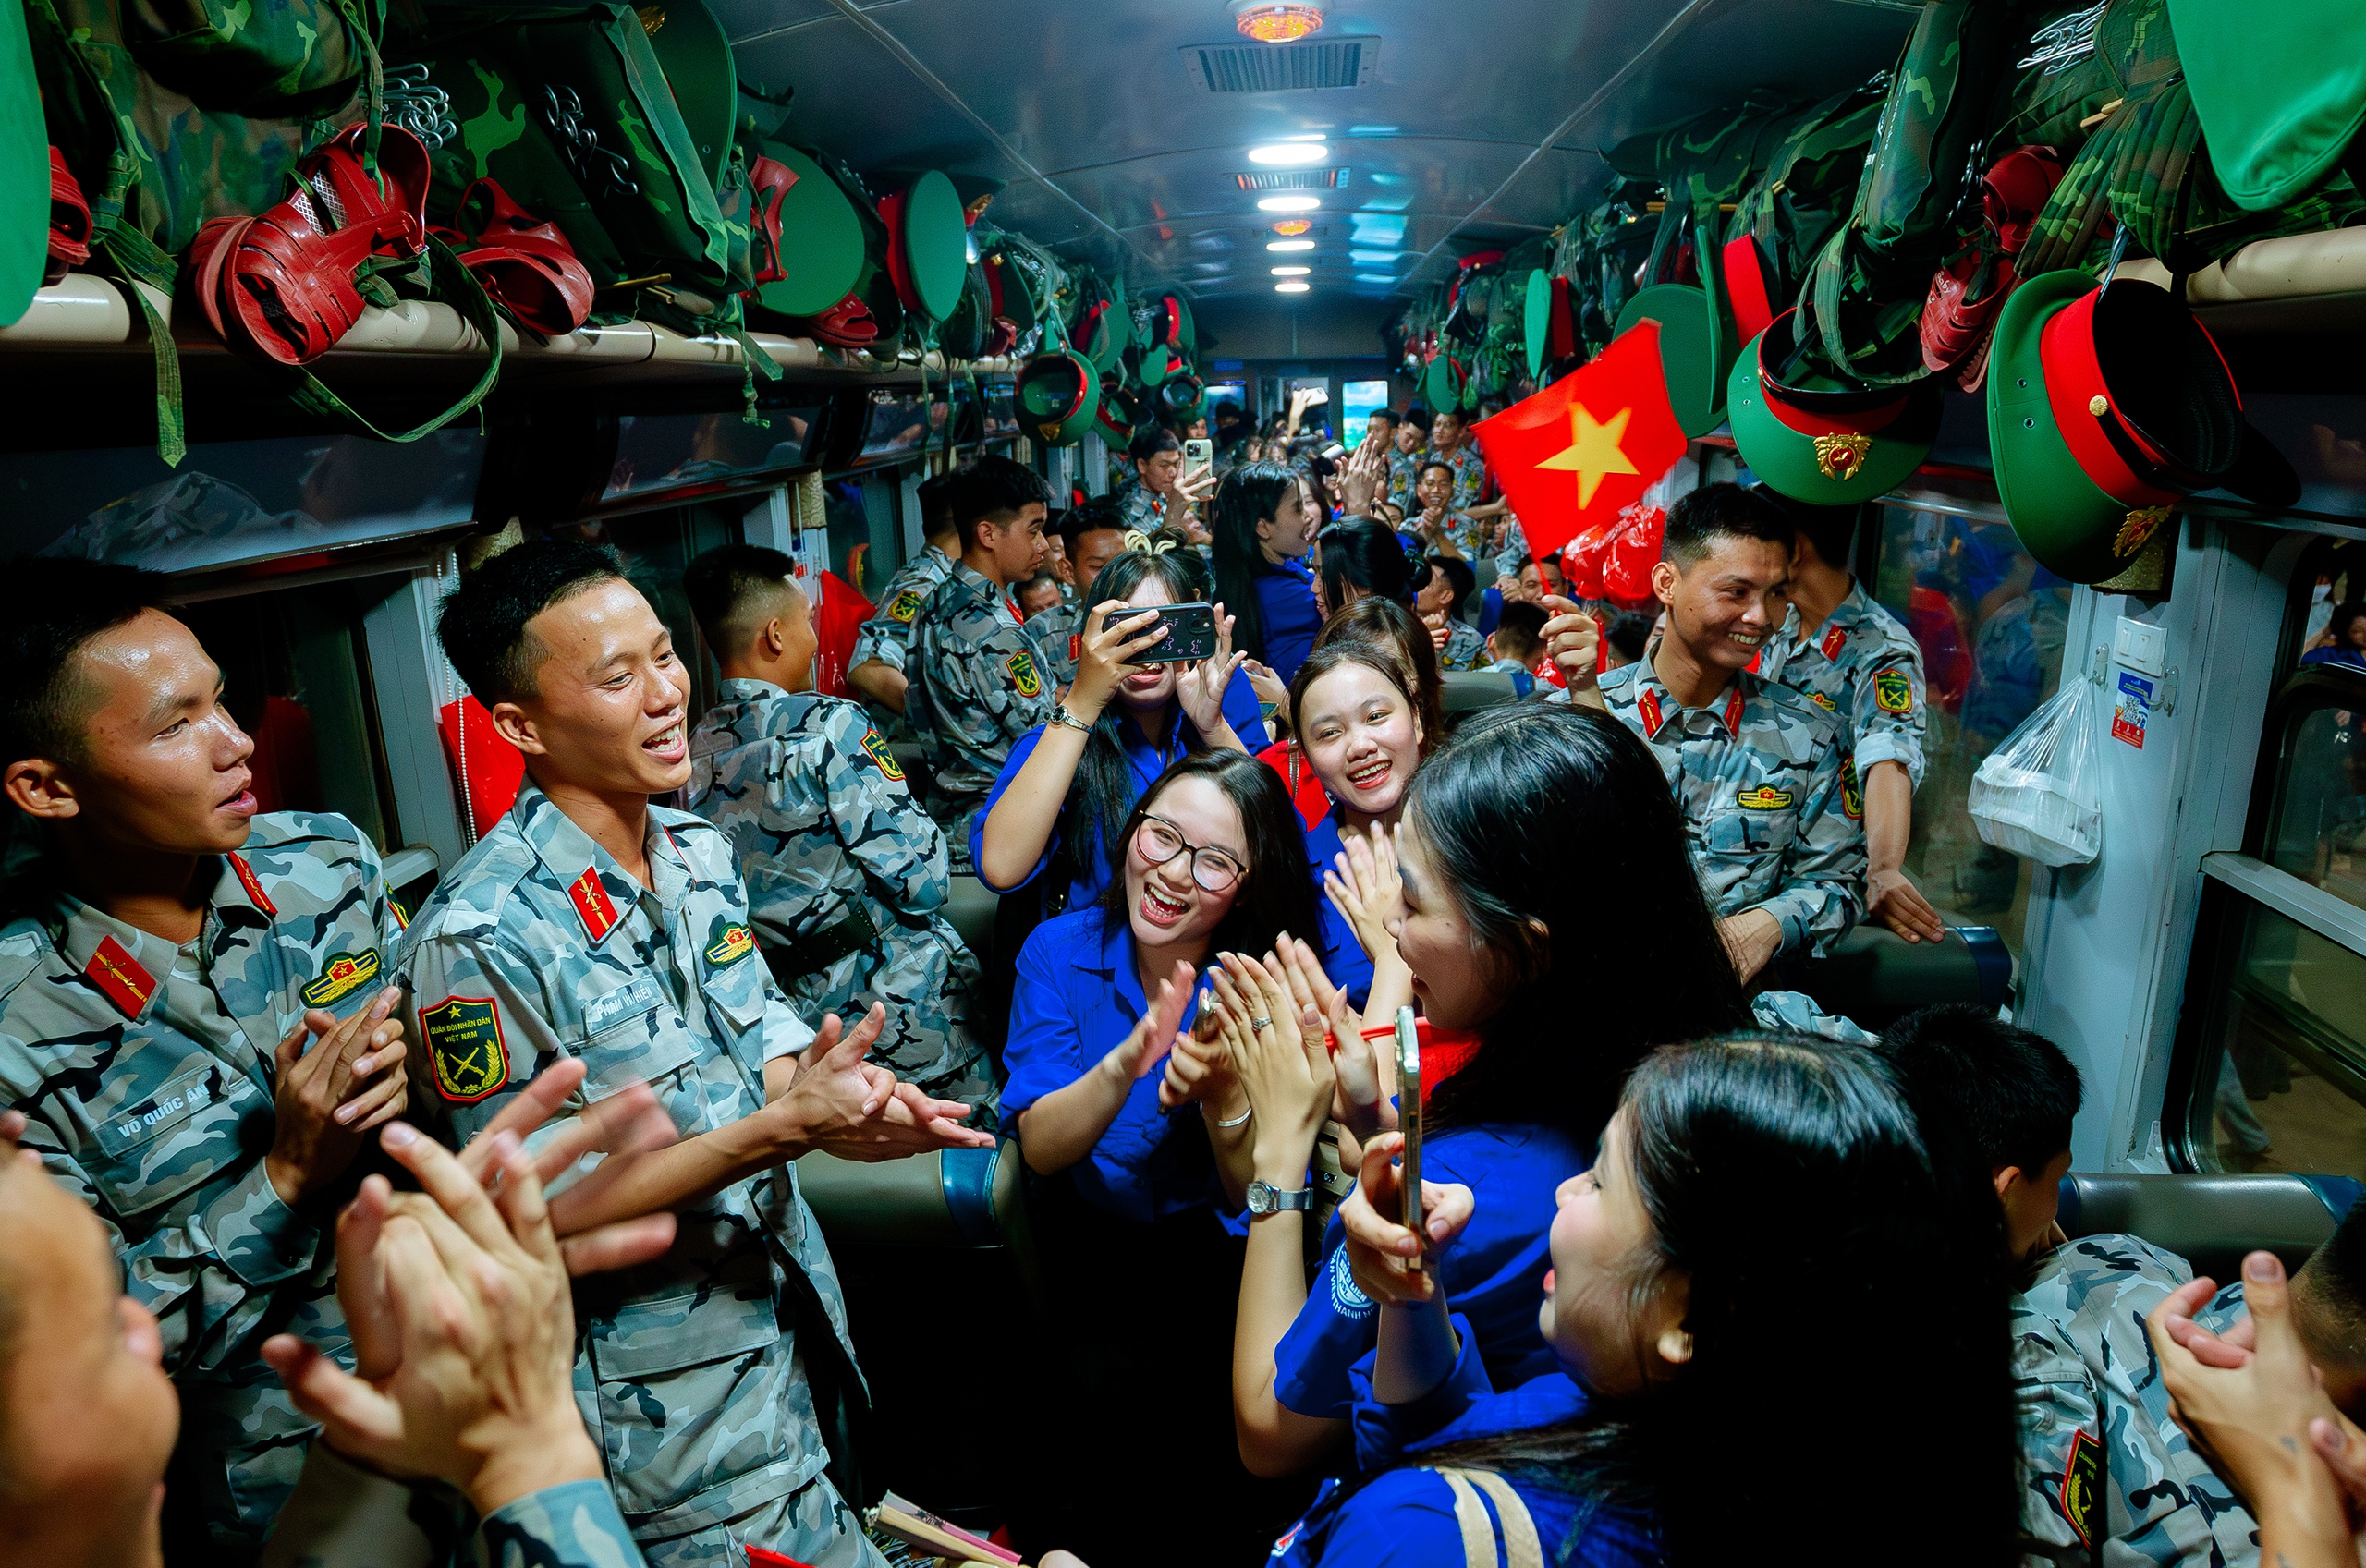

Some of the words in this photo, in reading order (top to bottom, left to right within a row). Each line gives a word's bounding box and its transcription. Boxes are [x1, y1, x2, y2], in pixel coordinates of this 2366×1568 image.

[597, 998, 624, 1016] PHẠM
[430, 1025, 446, 1035] QUÂN
[446, 1023, 457, 1033] ĐỘI
[457, 1019, 476, 1030] NHÂN
[476, 1016, 491, 1026] DÂN
[445, 1034, 459, 1043] VIỆT
[461, 1030, 478, 1040] NAM
[117, 1117, 142, 1138] VÕ
[143, 1096, 184, 1125] QUỐC
[186, 1083, 210, 1104] ÂN
